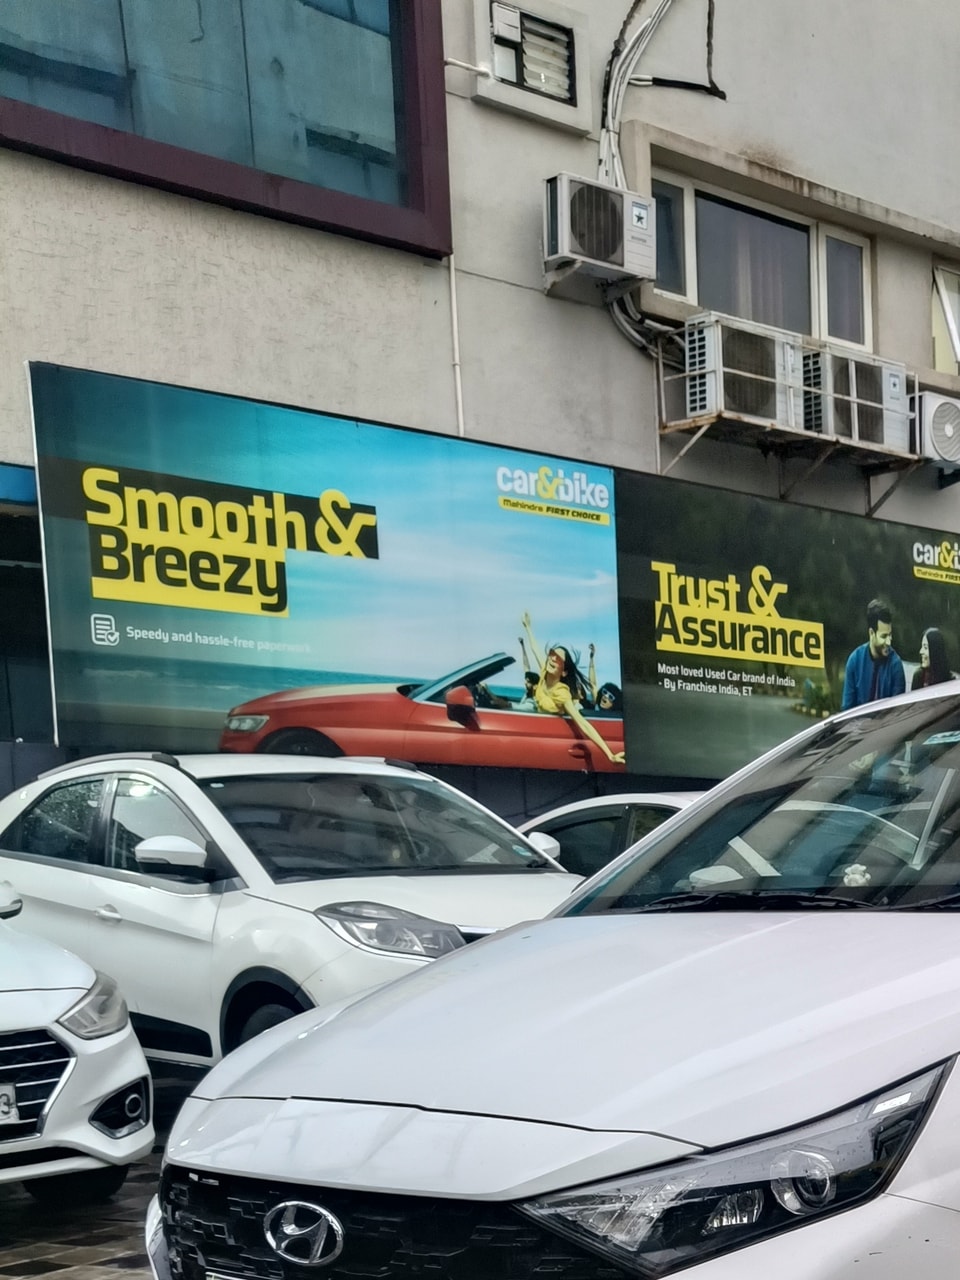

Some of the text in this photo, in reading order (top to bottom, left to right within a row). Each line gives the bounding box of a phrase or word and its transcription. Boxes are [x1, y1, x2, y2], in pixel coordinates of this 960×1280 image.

[496, 466, 609, 508] car&bike
[82, 467, 377, 558] Smooth &
[546, 505, 570, 517] FIRST
[571, 510, 601, 521] CHOICE
[91, 527, 288, 612] Breezy
[651, 561, 788, 618] Trust &
[126, 626, 169, 643] Speedy
[171, 631, 193, 643] and
[194, 632, 255, 649] hassle-free
[655, 603, 822, 660] Assurance
[657, 662, 796, 687] Most loved Used Car brand of India
[664, 678, 676, 691] By
[677, 680, 717, 693] Franchise
[718, 684, 742, 696] India,
[742, 686, 753, 696] ET
